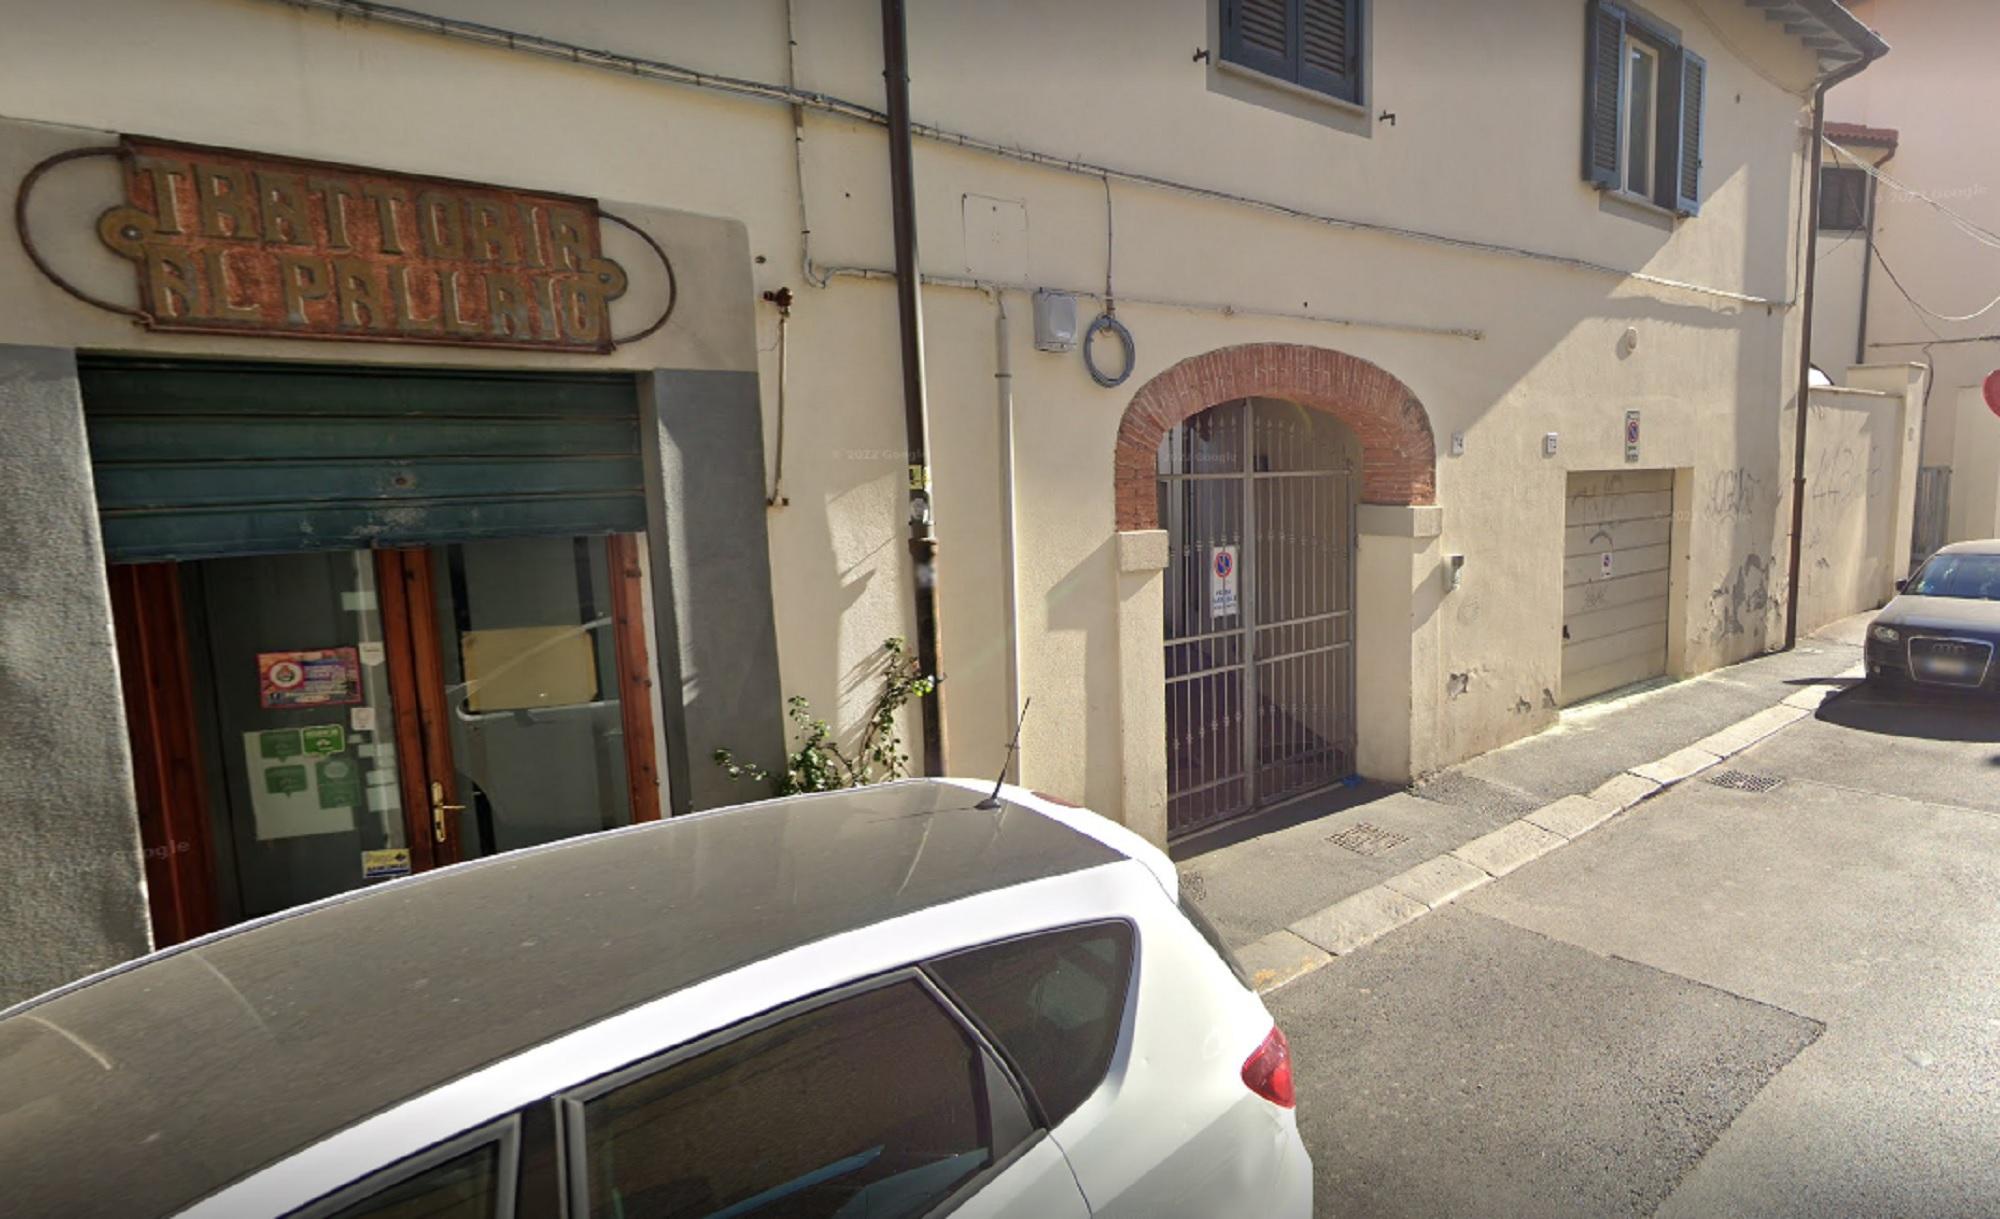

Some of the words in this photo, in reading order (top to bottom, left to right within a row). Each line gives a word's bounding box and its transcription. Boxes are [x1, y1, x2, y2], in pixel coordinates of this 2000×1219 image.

[135, 157, 596, 271] TRATTORIA
[147, 249, 265, 324] AL
[278, 252, 602, 345] PALLAIO
